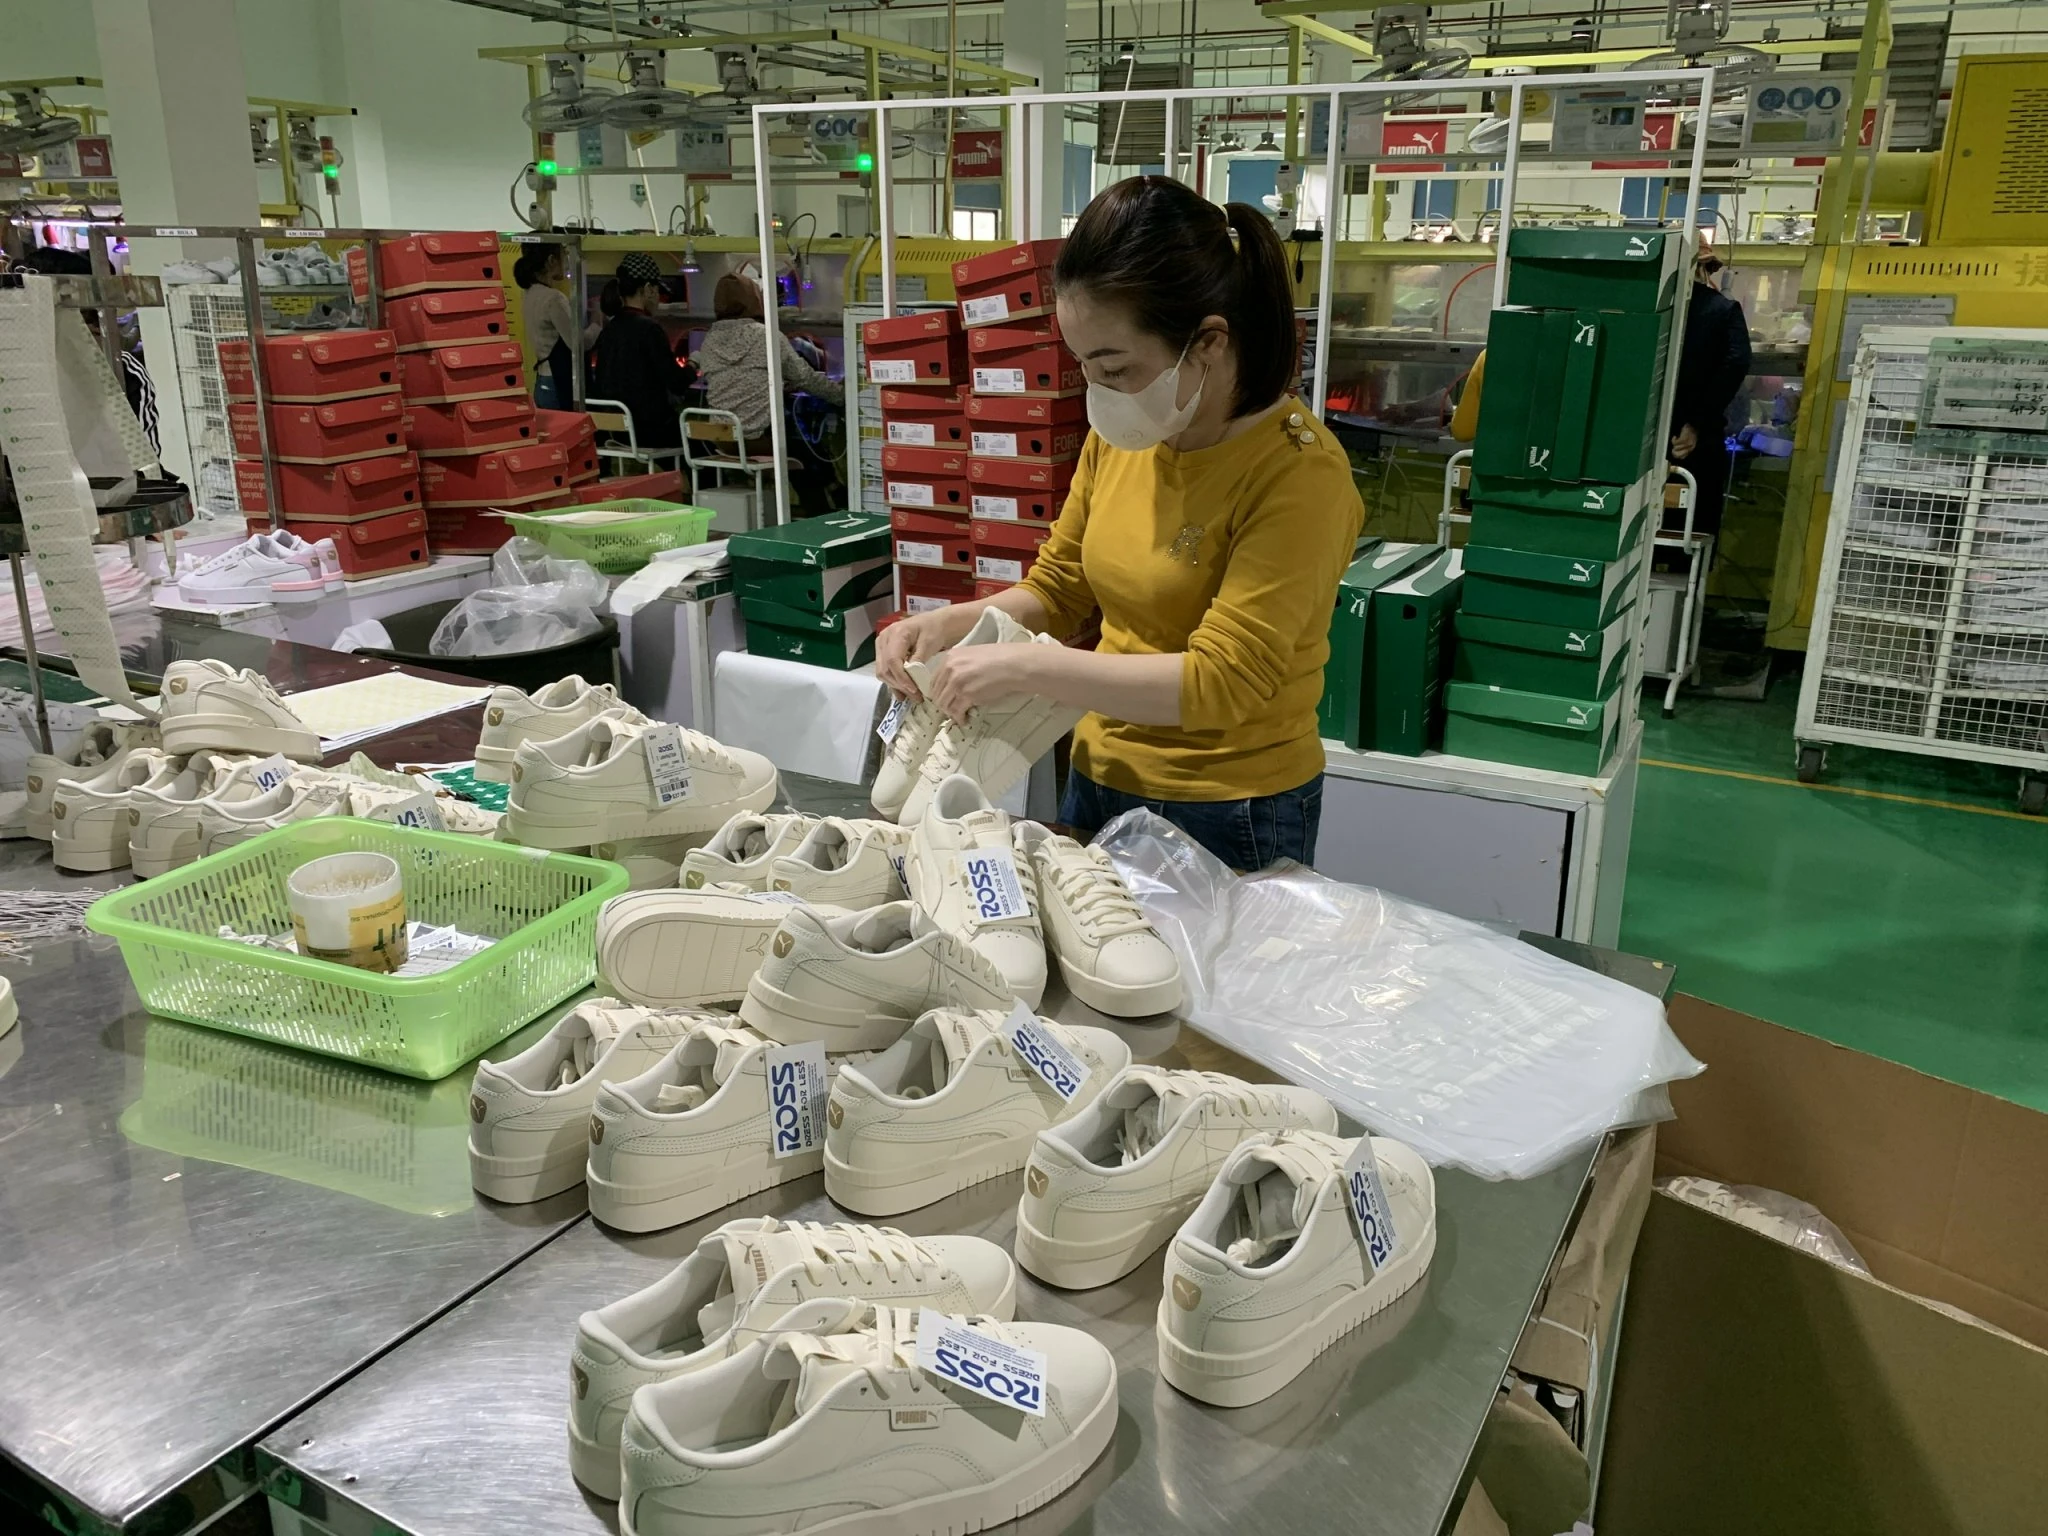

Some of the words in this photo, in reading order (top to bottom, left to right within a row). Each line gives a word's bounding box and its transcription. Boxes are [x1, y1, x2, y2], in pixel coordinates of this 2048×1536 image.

[955, 151, 988, 165] PUMA
[1011, 256, 1028, 266] PUMA
[1027, 409, 1044, 417] PUMA
[1029, 473, 1046, 482] PUMA
[1568, 574, 1587, 582] PUMA
[1564, 643, 1584, 651] PUMA
[880, 699, 903, 734] ROS
[1566, 716, 1586, 725] PUMA
[989, 858, 999, 877] LESS
[967, 859, 1002, 918] ROSS
[994, 878, 1005, 893] FOR
[1000, 894, 1012, 915] DRESS
[1022, 1023, 1040, 1043] LESS
[1040, 1044, 1057, 1061] FOR
[798, 1060, 806, 1086] LESS
[1011, 1029, 1077, 1098] ROSS
[1058, 1060, 1081, 1083] DRESS
[771, 1062, 801, 1152] ROSS
[800, 1089, 809, 1112] FOR
[802, 1115, 813, 1147] DRESS
[1368, 1193, 1379, 1215] FOR
[1350, 1171, 1387, 1268] ROSS
[1378, 1218, 1393, 1251] DRESS
[938, 1336, 967, 1355] LESS
[972, 1351, 999, 1367] FOR
[935, 1348, 1040, 1410] ROSS
[1003, 1363, 1041, 1382] DRESS
[895, 1410, 927, 1425] PUMA
